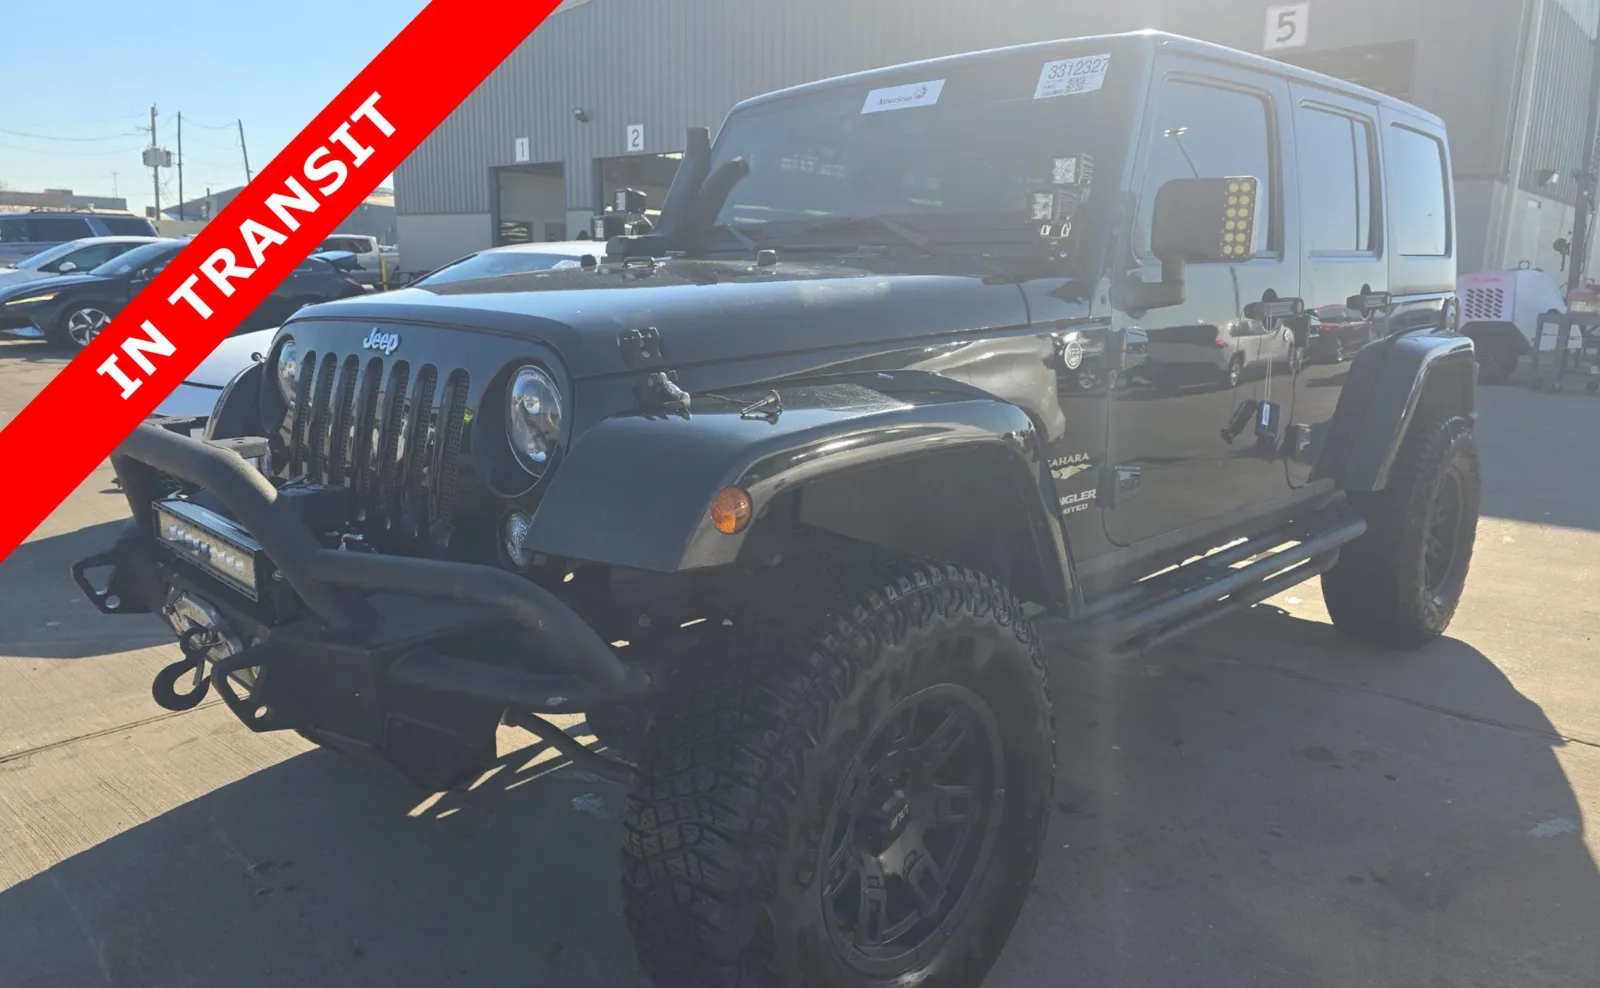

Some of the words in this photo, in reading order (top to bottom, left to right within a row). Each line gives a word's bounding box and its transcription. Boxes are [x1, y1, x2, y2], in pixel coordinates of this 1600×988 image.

[1275, 9, 1297, 43] 5
[1048, 58, 1108, 79] 3312327
[631, 128, 640, 148] 2
[363, 327, 399, 356] Jeep
[1059, 489, 1096, 505] NGLER
